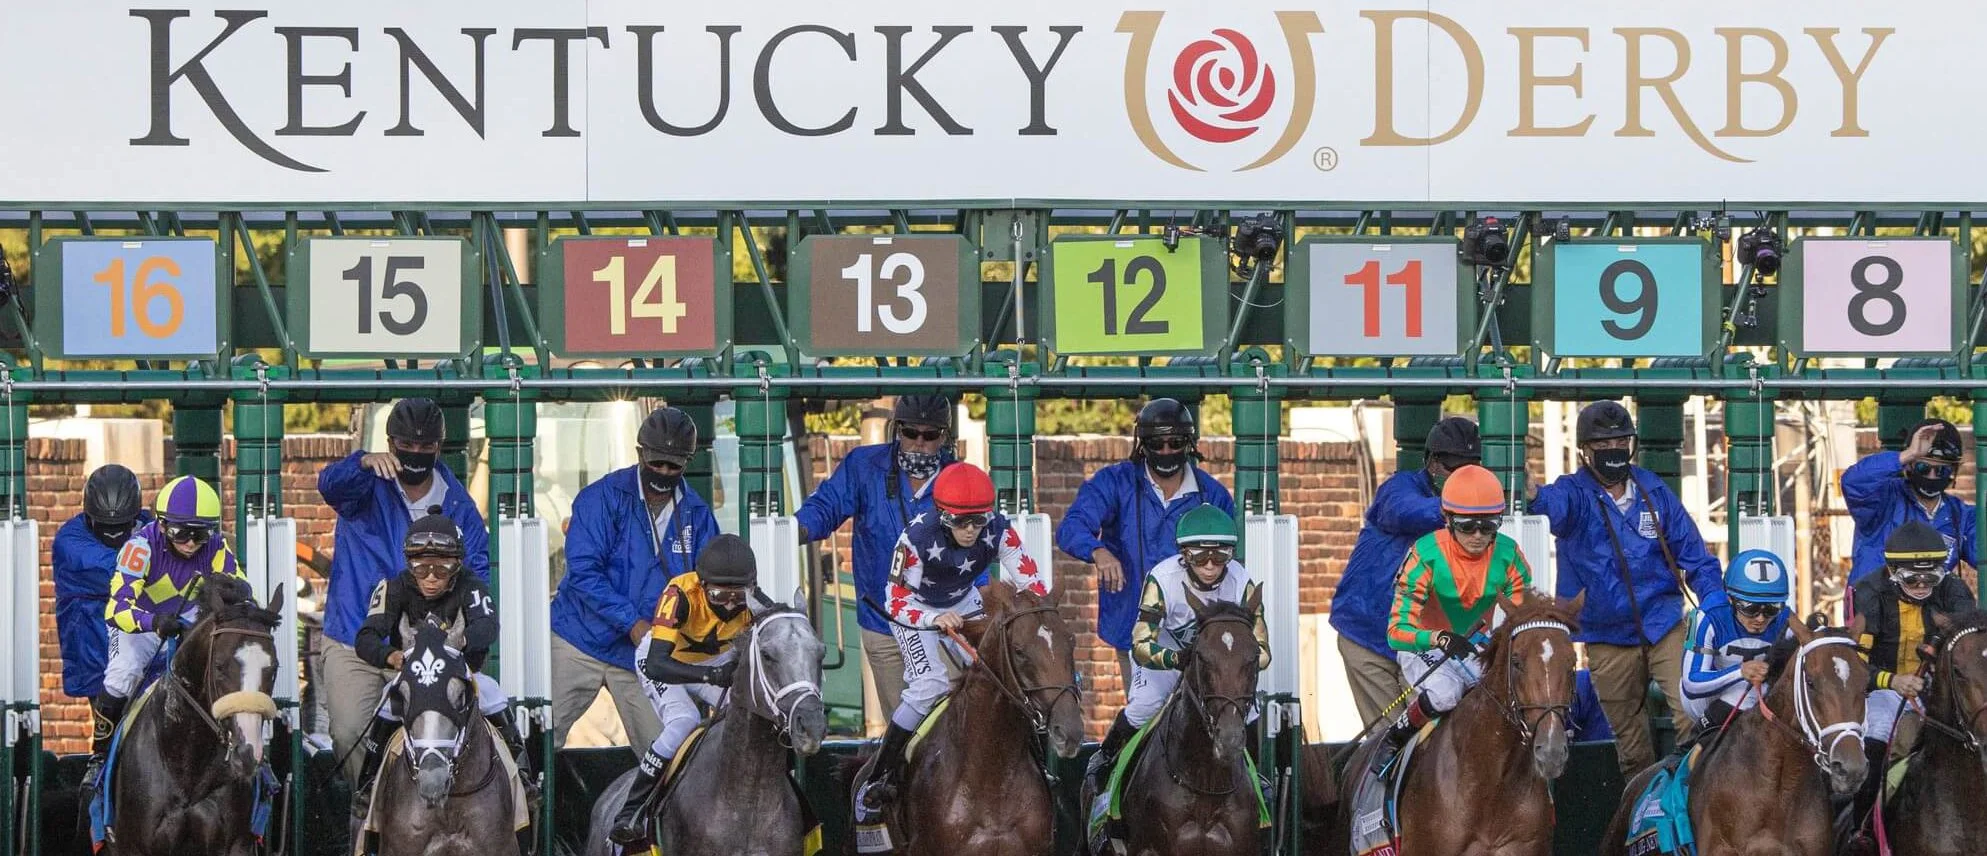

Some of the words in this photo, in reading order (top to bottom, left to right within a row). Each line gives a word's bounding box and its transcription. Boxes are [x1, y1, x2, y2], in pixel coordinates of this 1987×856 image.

[130, 9, 1084, 173] KENTUCKY
[1360, 9, 1896, 163] DERBY
[94, 256, 185, 339] 16
[342, 256, 429, 336] 15
[592, 255, 688, 335] 14
[841, 253, 929, 334] 13
[1087, 257, 1171, 336] 12
[1344, 260, 1423, 339] 11
[1599, 260, 1659, 341] 9
[1848, 257, 1908, 337] 8
[120, 542, 149, 572] 16
[1750, 560, 1774, 582] T
[656, 594, 677, 621] 14
[907, 631, 932, 676] RUBY'S
